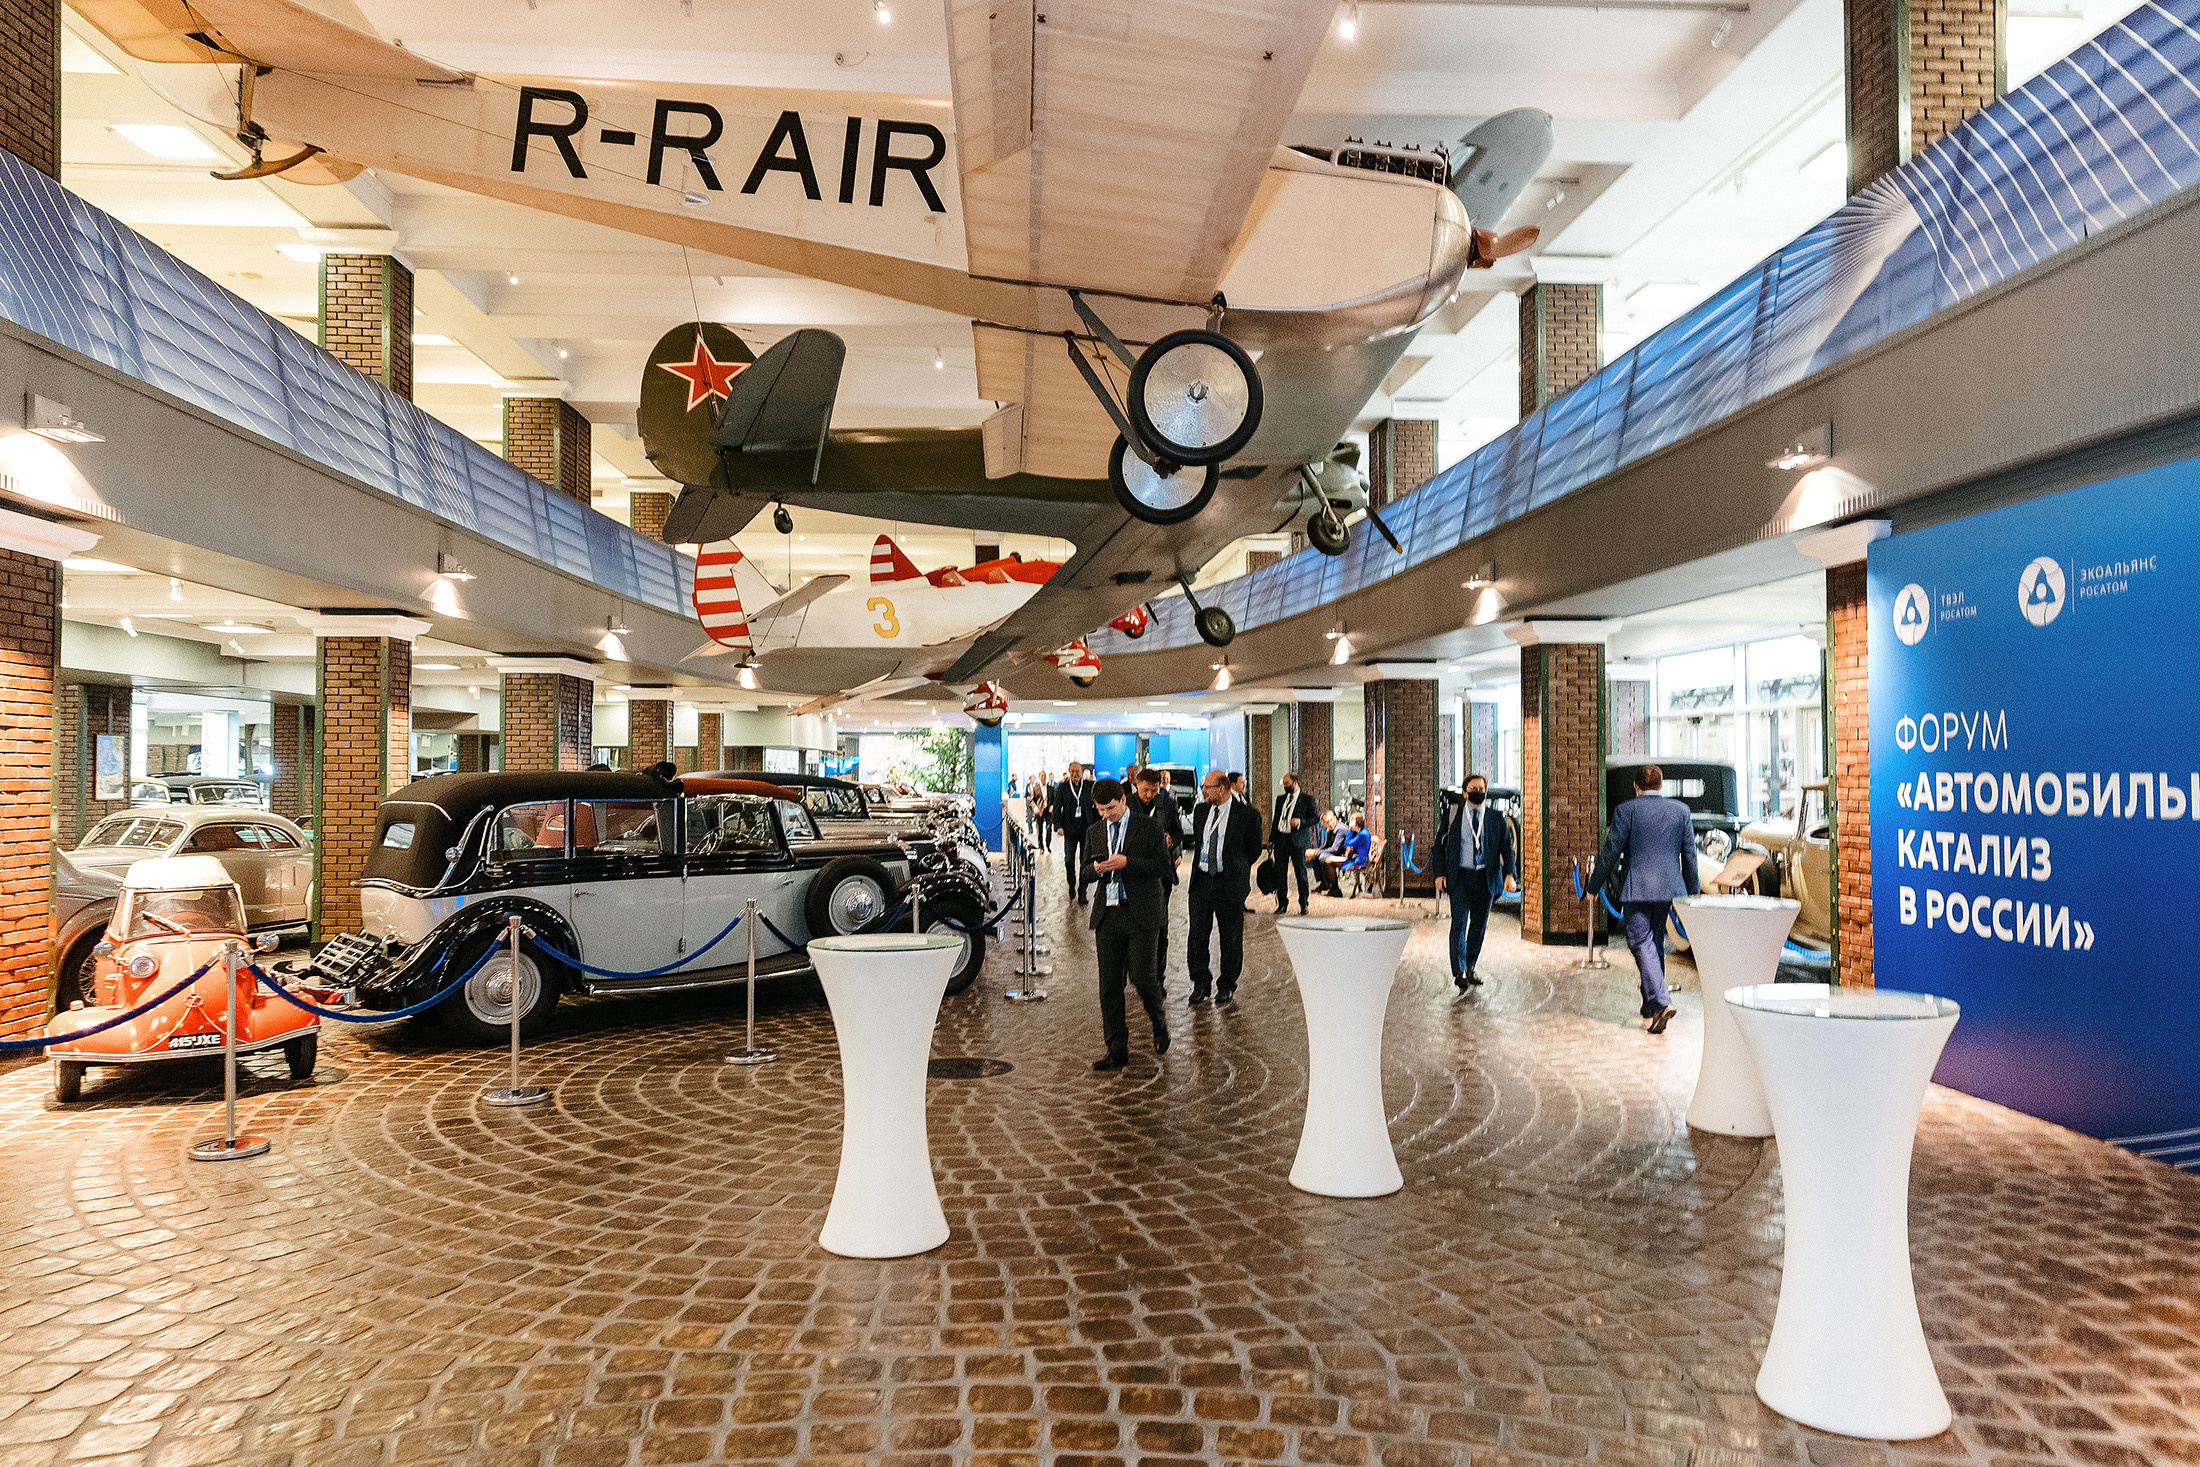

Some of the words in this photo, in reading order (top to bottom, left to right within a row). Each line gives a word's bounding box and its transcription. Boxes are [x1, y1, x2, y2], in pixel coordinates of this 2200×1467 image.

[511, 86, 947, 213] R-RAIR
[2080, 555, 2157, 582] ЭКОАЛЬЯНС
[2080, 580, 2128, 597] РОСАТОМ
[867, 597, 900, 638] 3
[1940, 606, 1977, 621] РОСАТОМ
[1941, 591, 1965, 607] ТВЭЛ
[1895, 709, 2008, 754] ФОРУМ
[1898, 828, 2051, 881] КАТАЛИЗ
[1899, 886, 1917, 925] В
[1927, 889, 2095, 951] РОССИИ»
